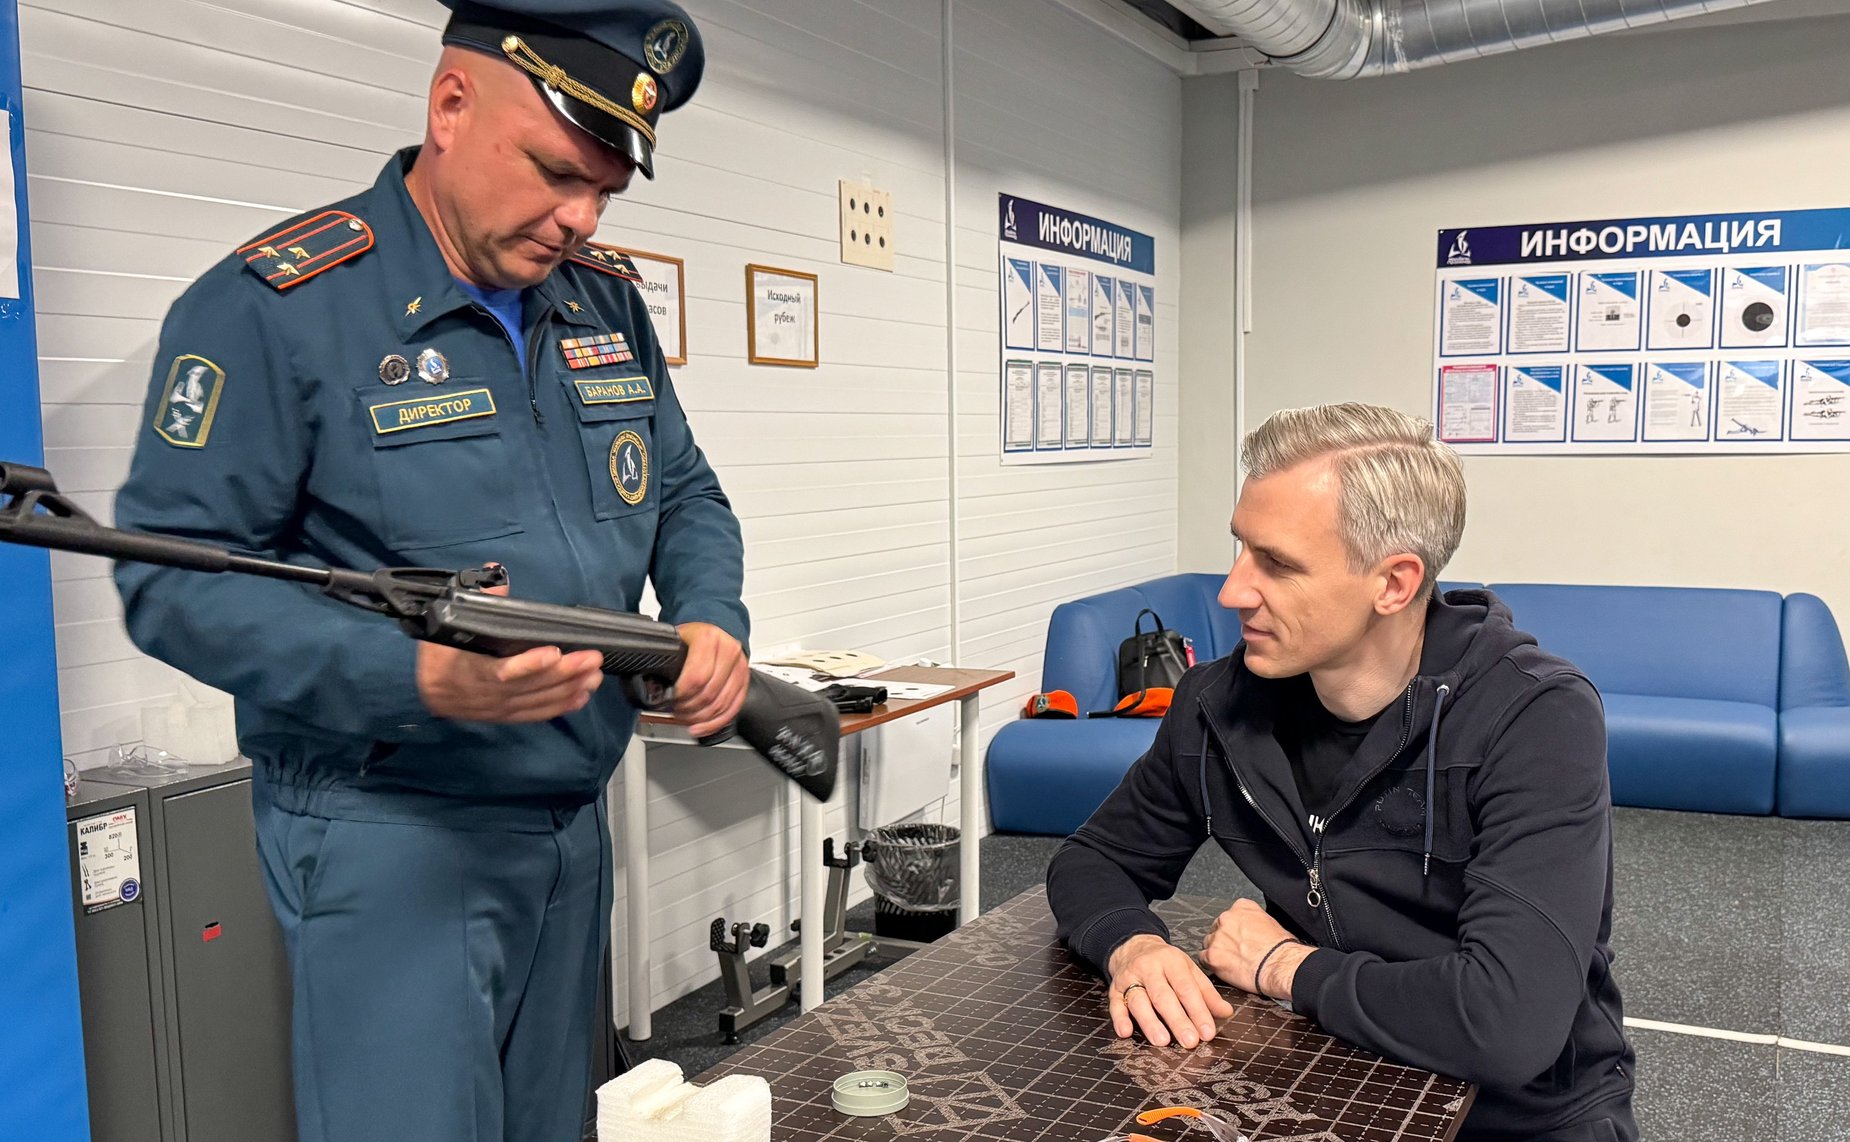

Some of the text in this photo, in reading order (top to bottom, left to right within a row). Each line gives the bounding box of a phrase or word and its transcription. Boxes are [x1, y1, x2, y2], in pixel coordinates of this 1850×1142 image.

[1038, 211, 1132, 264] ИНФОРМАЦИЯ
[1520, 218, 1782, 259] ИНФОРМАЦИЯ
[767, 289, 801, 304] Исходный
[774, 312, 796, 325] рубеж
[586, 385, 626, 398] БАРАНОВ
[398, 398, 473, 425] ДИРЕКТОР
[80, 822, 108, 836] КАЛИБР
